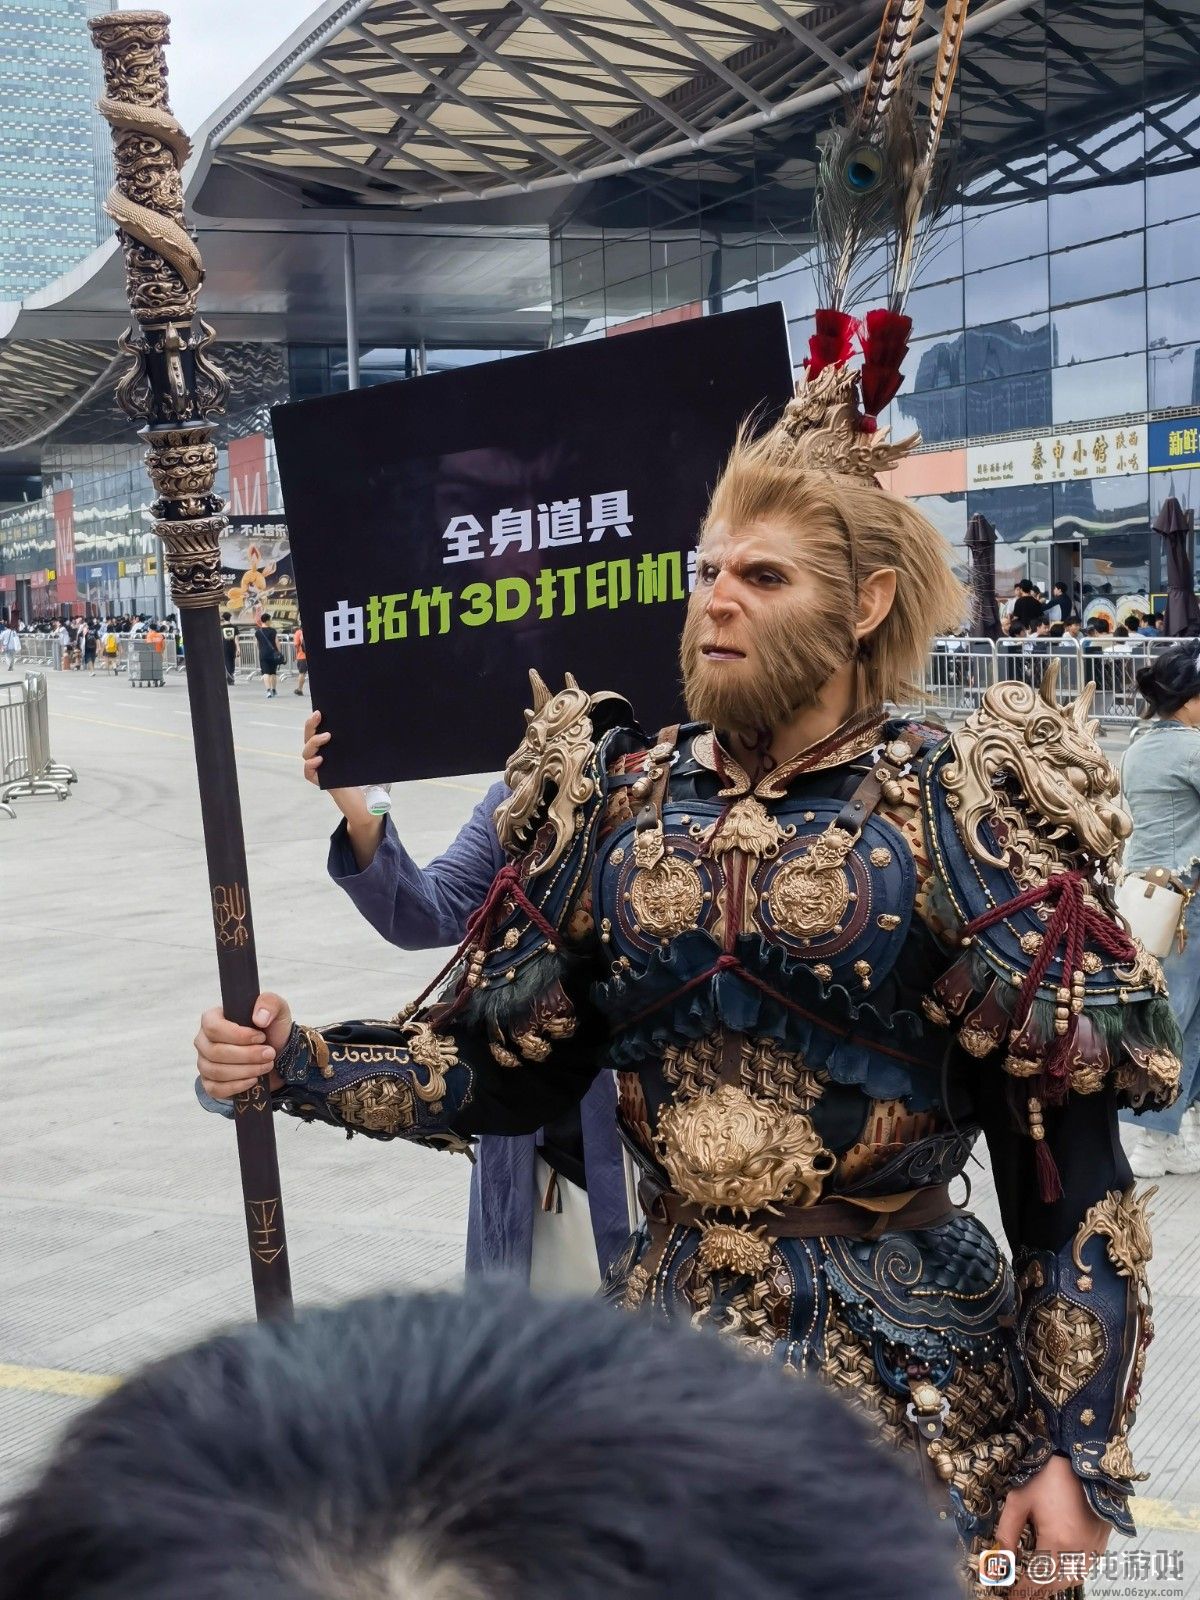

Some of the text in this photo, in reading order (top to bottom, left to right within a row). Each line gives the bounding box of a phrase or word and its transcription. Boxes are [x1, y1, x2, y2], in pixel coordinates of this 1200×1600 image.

[1169, 428, 1200, 456] 新鲜
[240, 523, 288, 537] 不止音乐
[442, 489, 634, 564] 全身道具
[324, 546, 701, 649] 由拓竹3D打印机
